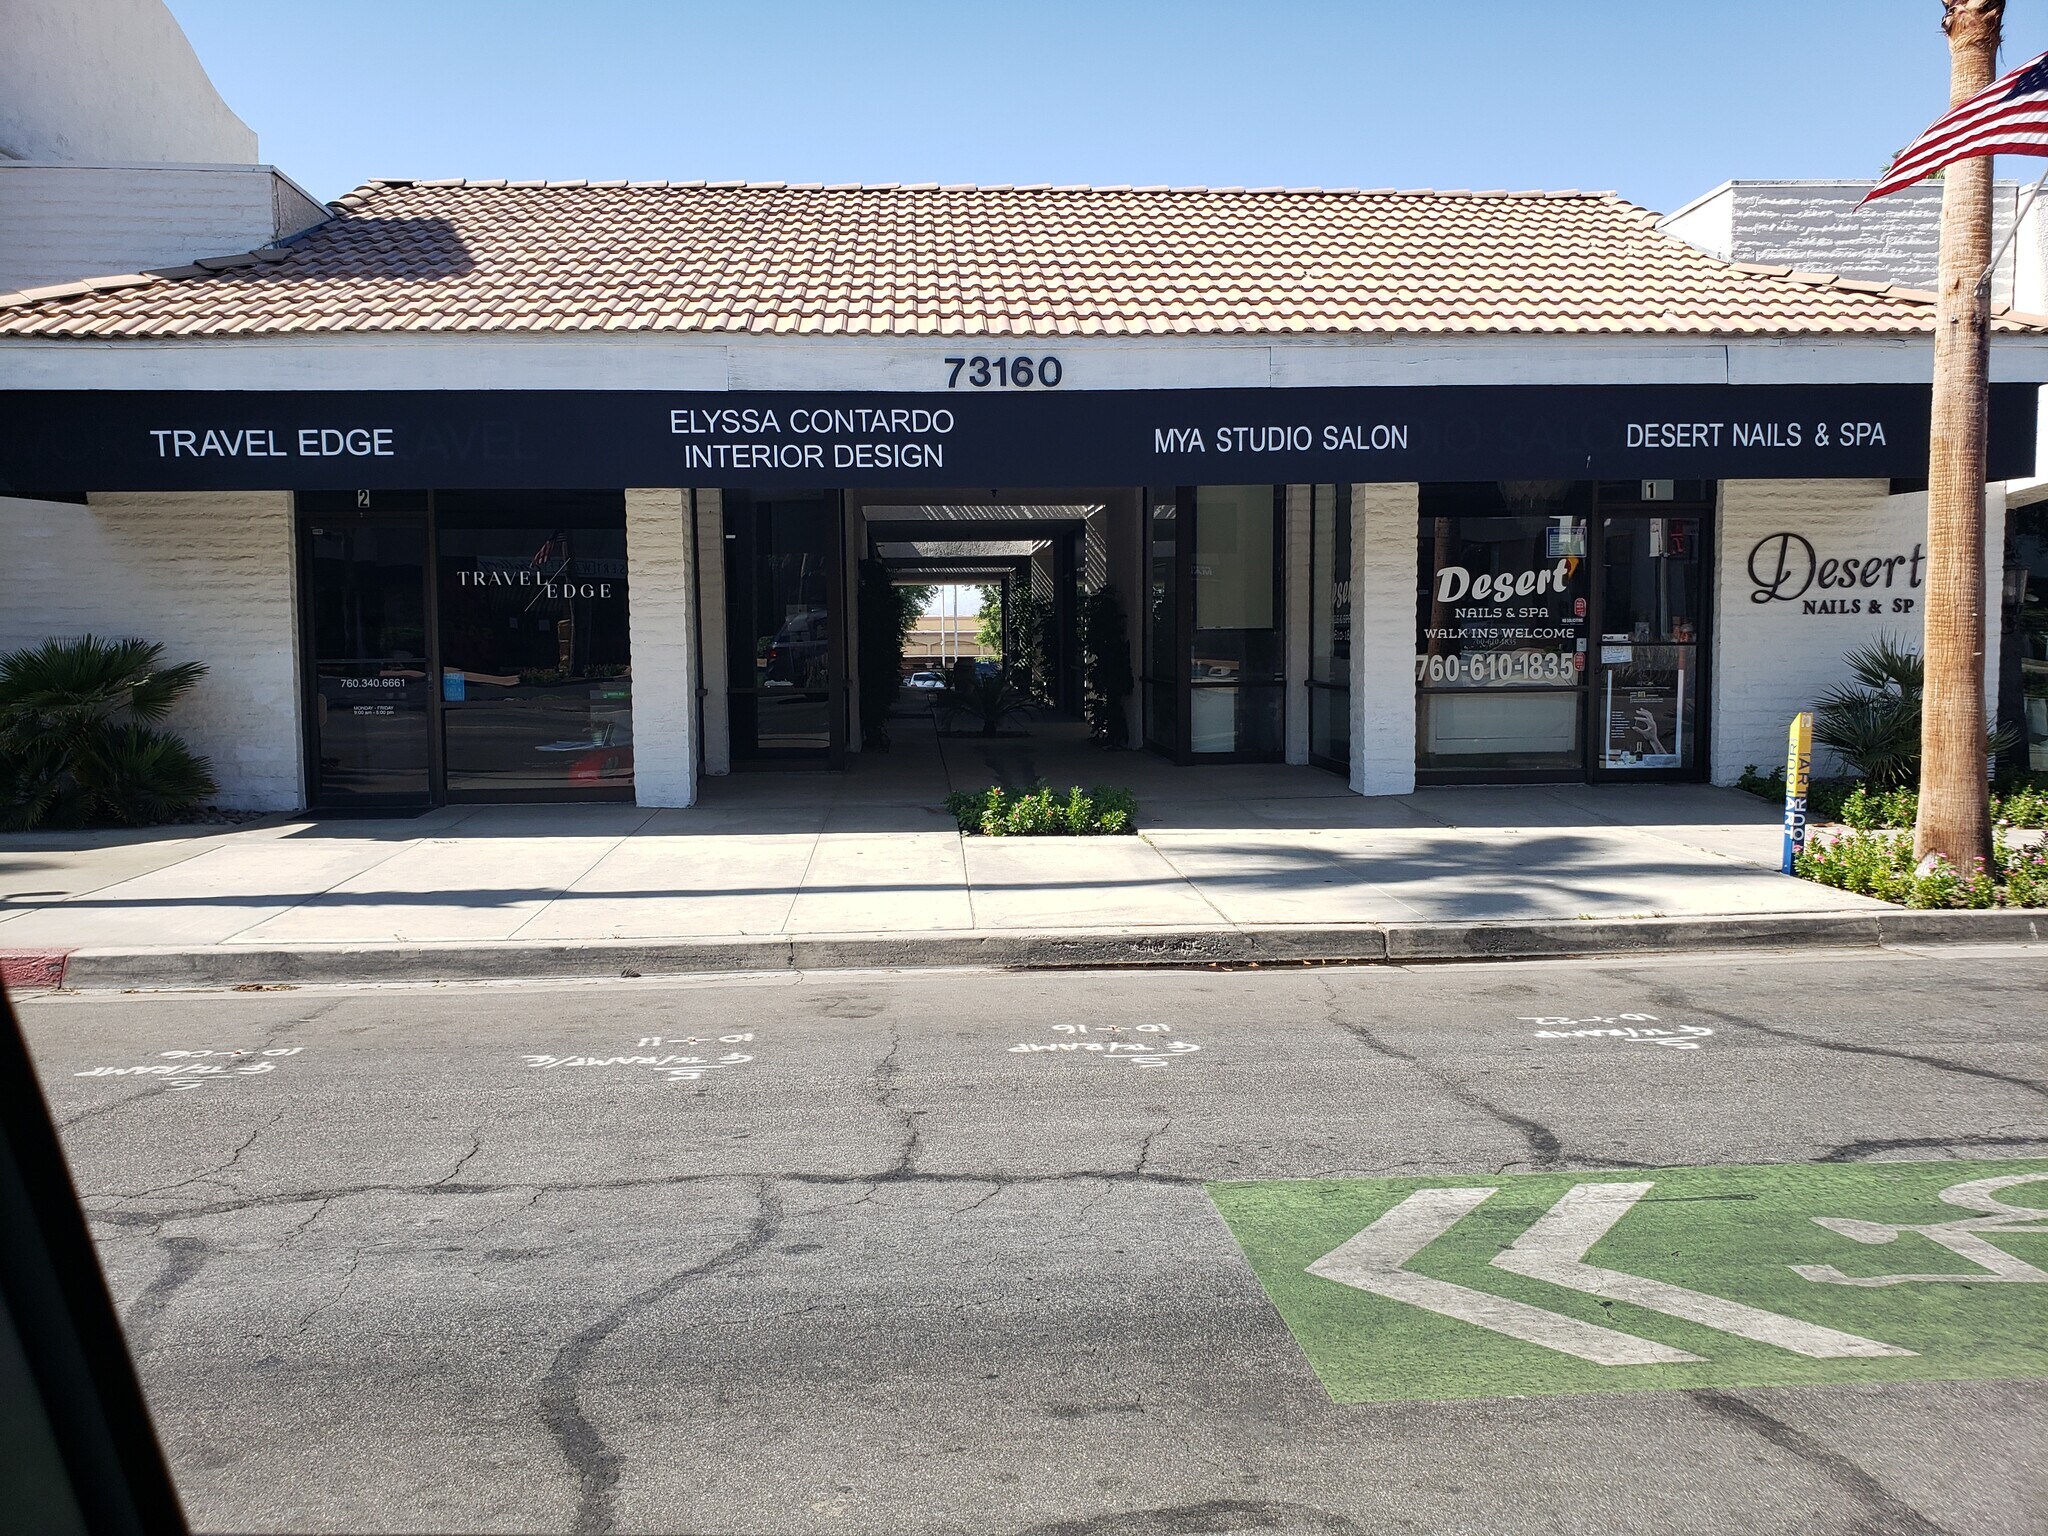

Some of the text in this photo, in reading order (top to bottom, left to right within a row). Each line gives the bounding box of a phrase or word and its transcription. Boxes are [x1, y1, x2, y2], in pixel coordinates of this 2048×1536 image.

[945, 356, 1063, 392] 73160
[671, 409, 955, 434] ELYSSA CONTARDO
[150, 429, 394, 457] TRAVEL EDGE
[1155, 424, 1408, 454] MYA STUDIO SALON
[1626, 422, 1887, 448] DESERT NAILS & SPA
[684, 444, 943, 469] INTERIOR DESIGN
[359, 490, 369, 507] 2
[1647, 482, 1654, 499] 1
[457, 571, 548, 586] TRAVEL
[1436, 558, 1568, 603] Desert
[1748, 532, 1926, 605] Desert
[547, 583, 612, 599] EDGE
[1455, 607, 1549, 618] NAILS & SPA
[1802, 598, 1921, 615] NAILS & SP
[1424, 628, 1575, 639] WALK INS WELCOME
[1416, 652, 1574, 682] 760-610-1835
[341, 678, 405, 688] 760.340.6661
[1784, 797, 1796, 840] ART
